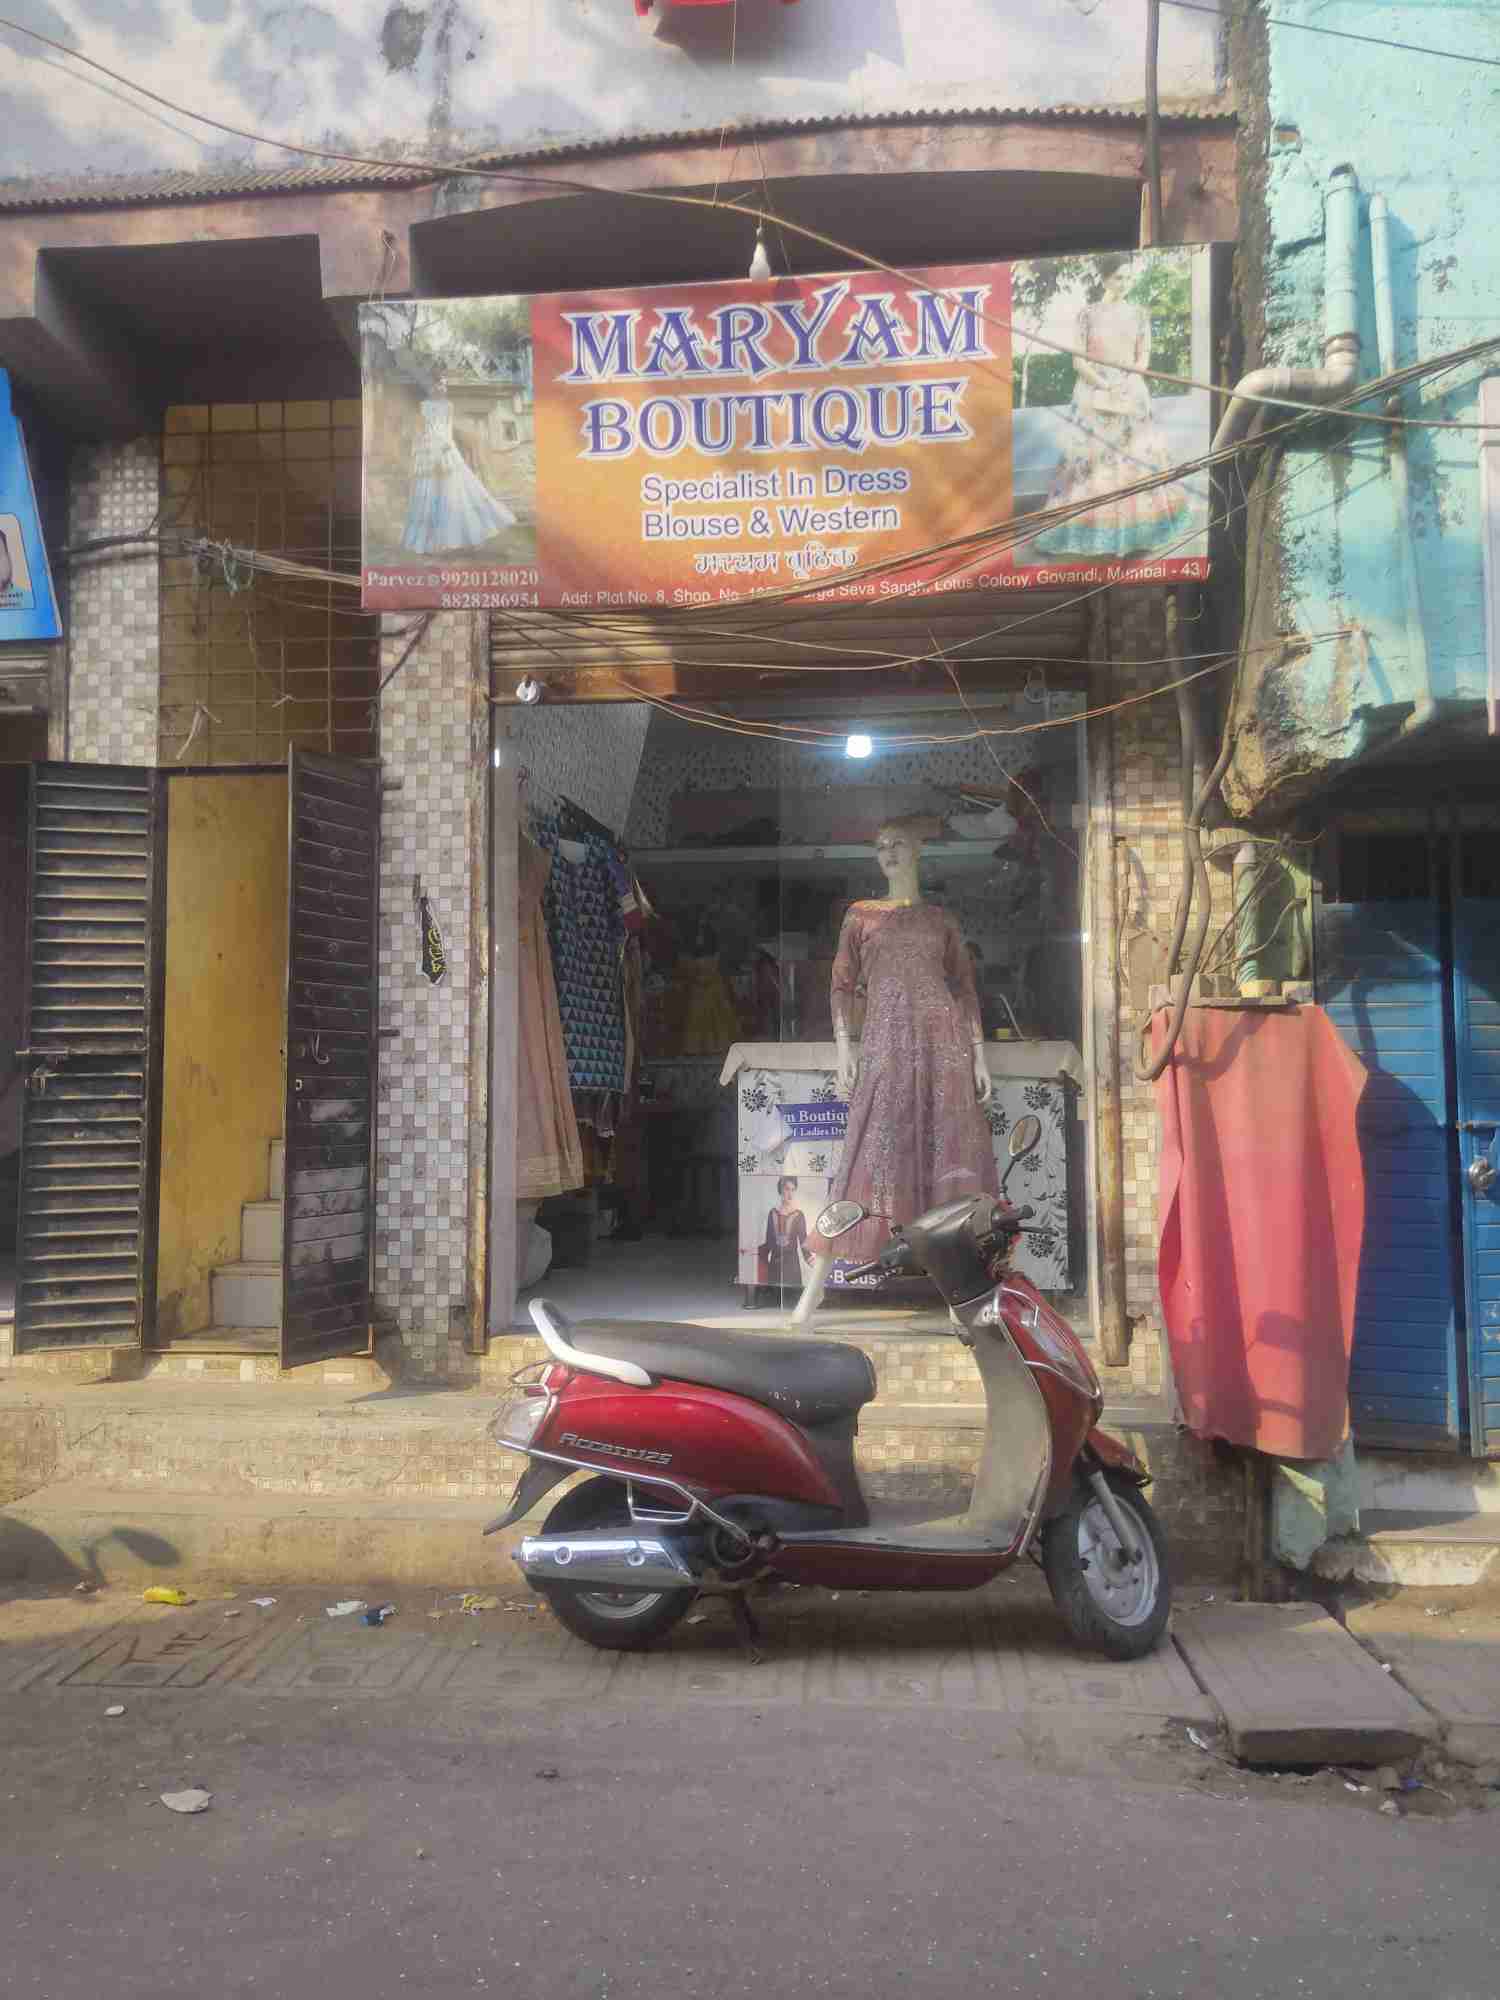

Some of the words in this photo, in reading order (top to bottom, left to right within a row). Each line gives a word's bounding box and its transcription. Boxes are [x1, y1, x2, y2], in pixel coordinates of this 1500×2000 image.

[557, 282, 995, 382] MARYAM
[580, 378, 971, 458] BOUTIQUE
[643, 472, 779, 506] Specialist
[788, 471, 814, 496] In
[824, 468, 909, 494] Dress
[644, 513, 740, 538] Blouse
[750, 509, 771, 535] &
[778, 505, 899, 533] Western
[367, 571, 425, 587] Parvez
[440, 570, 539, 587] 9920128020
[560, 590, 593, 606] Add:
[838, 581, 875, 597] Seva
[1107, 560, 1167, 580] Mumbai
[440, 591, 540, 608] 8828286954
